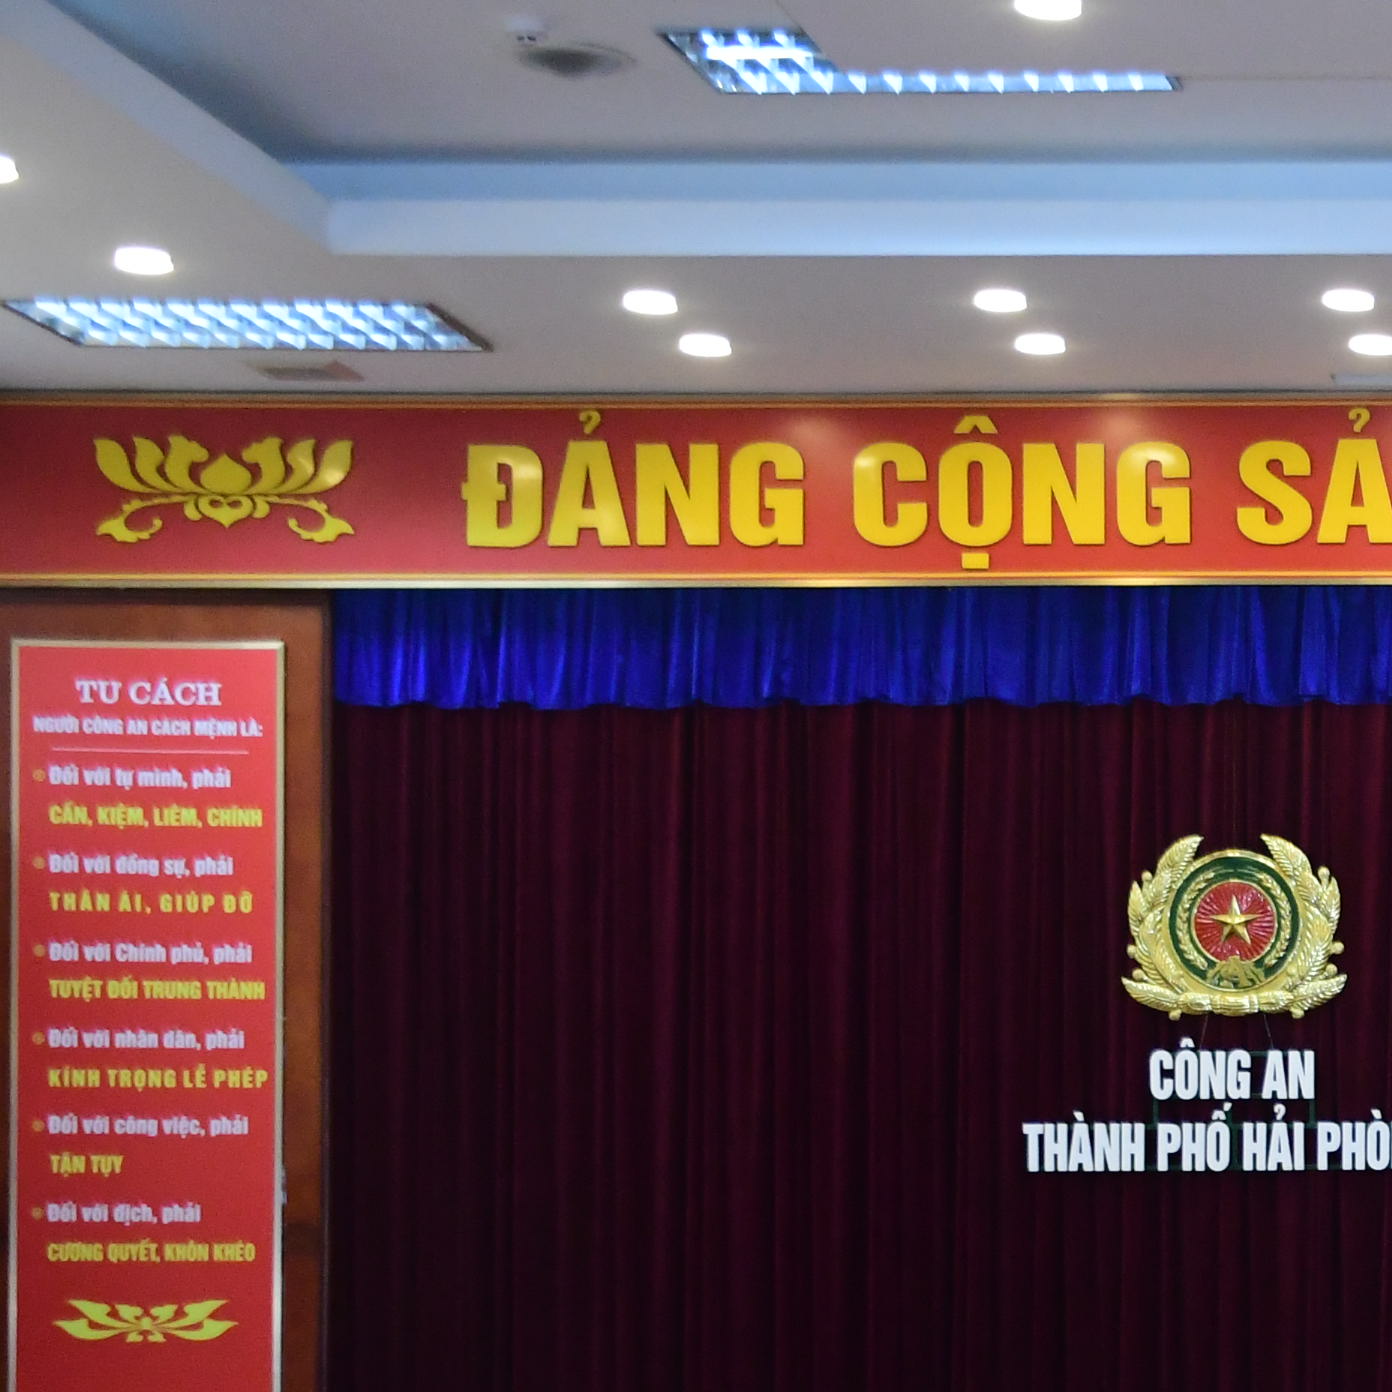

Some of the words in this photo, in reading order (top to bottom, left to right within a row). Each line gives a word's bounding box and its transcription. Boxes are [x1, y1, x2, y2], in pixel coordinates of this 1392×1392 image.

[462, 410, 804, 548] ĐẢNG
[853, 415, 1189, 569] CỘNG
[129, 677, 222, 705] CÁCH
[127, 719, 148, 735] AN
[142, 980, 201, 999] TRUNG
[107, 1069, 176, 1091] TRỌNG
[1149, 1037, 1251, 1100] CÔNG
[1261, 1050, 1314, 1099] AN
[1022, 1111, 1145, 1172] THÀNH
[1157, 1102, 1232, 1171] PHỐ
[1242, 1104, 1305, 1171] HẢI
